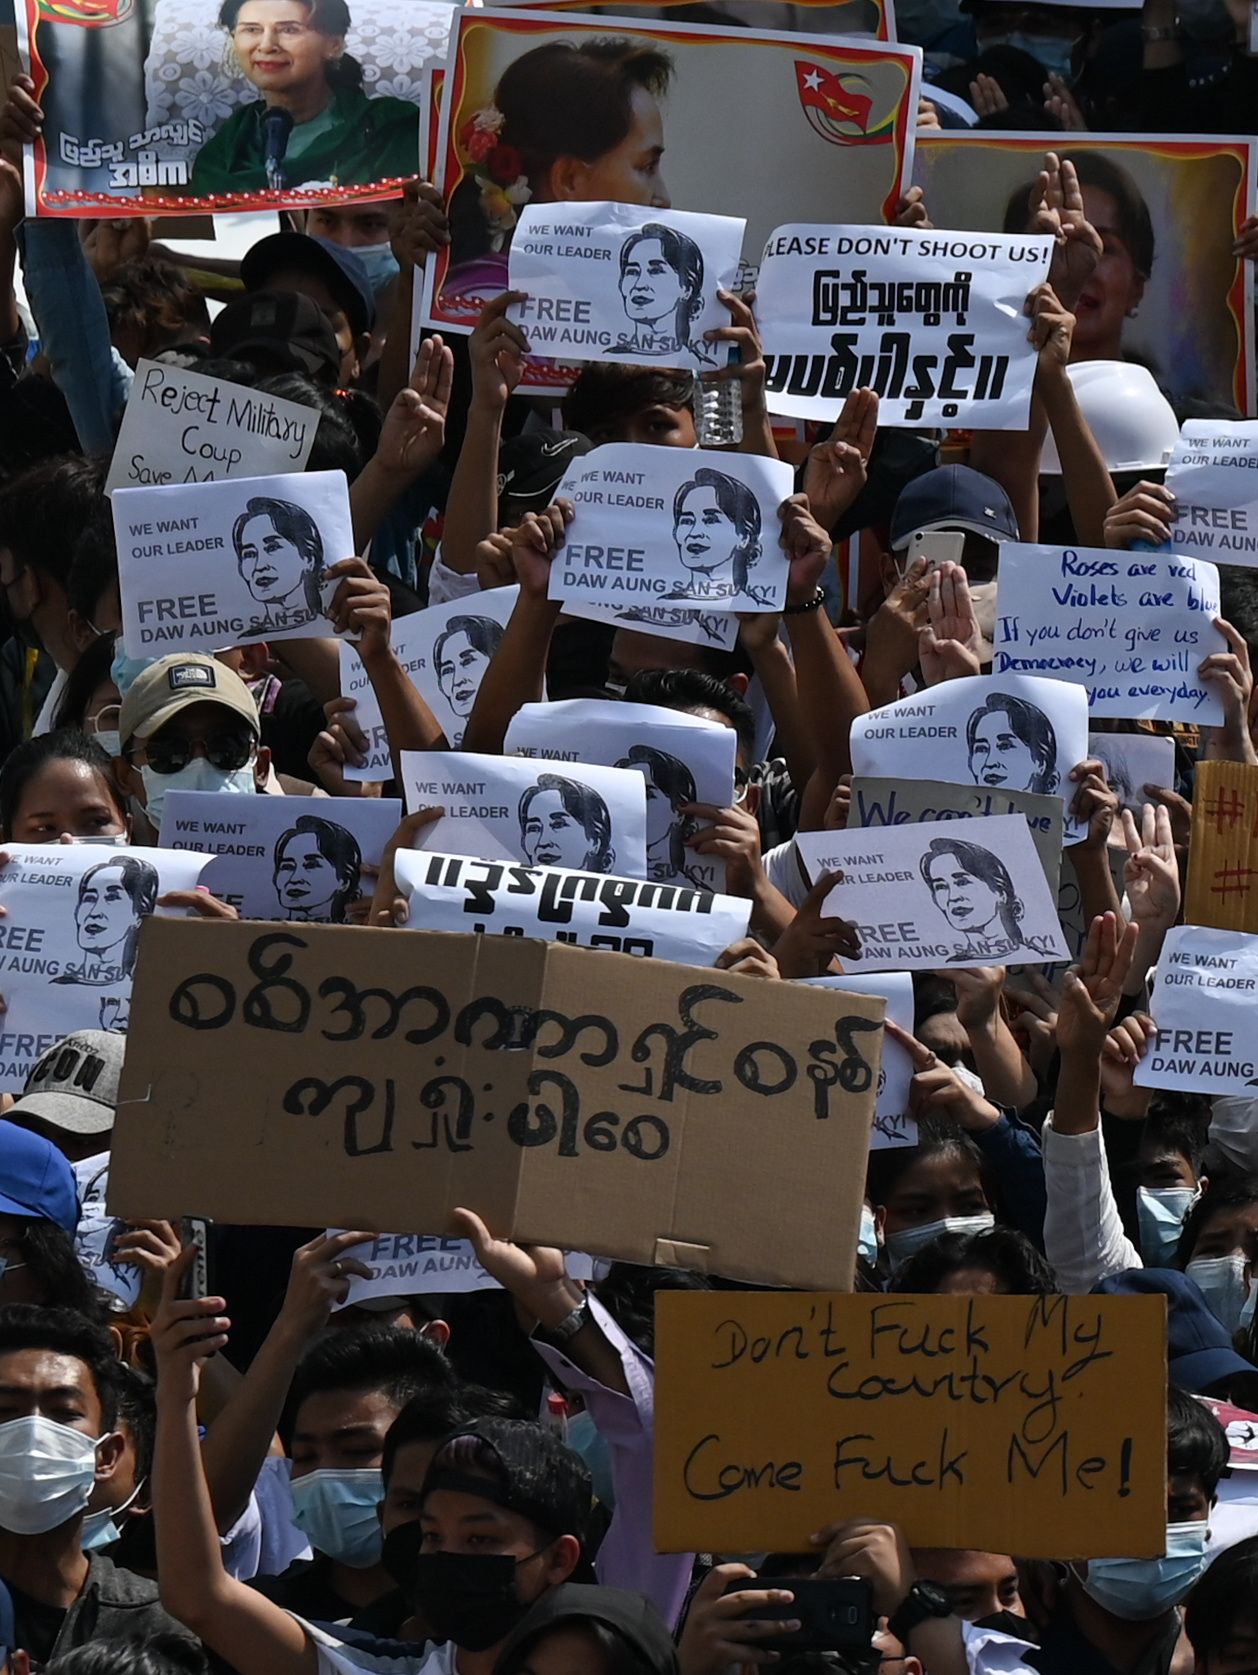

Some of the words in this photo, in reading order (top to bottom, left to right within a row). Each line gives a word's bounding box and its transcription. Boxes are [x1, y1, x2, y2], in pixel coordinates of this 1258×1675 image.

[528, 225, 549, 236] WE
[553, 225, 593, 237] WANT
[523, 244, 553, 255] OUR
[557, 246, 612, 261] LEADER
[837, 238, 911, 255] DON'T
[918, 240, 1002, 260] SHOOT
[1008, 246, 1049, 264] US!
[812, 270, 972, 327] ပြည်သူတွေကို
[519, 297, 592, 325] FREE
[562, 329, 611, 346] AUNG
[142, 368, 221, 424] Reject
[227, 398, 306, 459] Military
[181, 425, 241, 473] Coup
[1188, 439, 1207, 448] WE
[1212, 439, 1249, 448] WANT
[1182, 456, 1209, 465] OUR
[128, 455, 172, 486] Save
[581, 471, 598, 483] WE
[602, 471, 646, 485] WANT
[574, 492, 604, 504] OUR
[607, 495, 664, 510] LEADER
[130, 524, 153, 536] WE
[157, 518, 199, 532] WANT
[1175, 505, 1248, 531] FREE
[1173, 530, 1214, 547] DAW
[132, 545, 163, 559] OUR
[167, 537, 224, 554] LEADER
[565, 544, 645, 572] FREE
[1062, 550, 1120, 578] Roses
[1127, 559, 1157, 576] are
[1168, 563, 1197, 580] red
[563, 572, 607, 589] DAW
[611, 576, 665, 593] AUNG
[1052, 583, 1127, 608] Violets
[1139, 591, 1174, 607] are
[138, 594, 217, 623] FREE
[140, 626, 184, 643] DAW
[190, 619, 244, 637] AUNG
[998, 616, 1020, 643] If
[1026, 625, 1059, 646] you
[1067, 618, 1117, 639] don't
[1125, 626, 1160, 651] give
[1175, 630, 1198, 644] us
[1115, 660, 1147, 673] we
[1152, 651, 1189, 673] will
[894, 706, 936, 718] WANT
[864, 728, 895, 739] OUR
[900, 726, 957, 738] LEADER
[415, 782, 438, 794] WE
[443, 783, 486, 795] WANT
[451, 806, 509, 818] LEADER
[858, 790, 910, 827] We
[176, 820, 198, 832] WE
[203, 822, 245, 834] WANT
[208, 842, 265, 857] LEADER
[30, 856, 62, 866] WANT
[818, 857, 841, 867] WE
[846, 854, 884, 866] WANT
[20, 874, 72, 887] LEADER
[858, 871, 914, 884] LEADER
[898, 944, 949, 958] AUNG
[8, 957, 60, 975] AUNG
[1169, 953, 1190, 964] WE
[1195, 955, 1237, 968] WANT
[1165, 974, 1194, 985] OUR
[1198, 976, 1255, 989] LEADER
[1155, 1029, 1233, 1055] FREE
[1151, 1058, 1196, 1074] DAW
[1200, 1062, 1254, 1077] AUNG
[371, 1262, 418, 1280] DAW
[712, 1303, 846, 1369] Don't
[870, 1298, 989, 1360] Fuck
[1024, 1296, 1113, 1381] My
[683, 1435, 801, 1501] Come
[834, 1428, 968, 1491] Fuck
[1007, 1431, 1133, 1498] Me!
